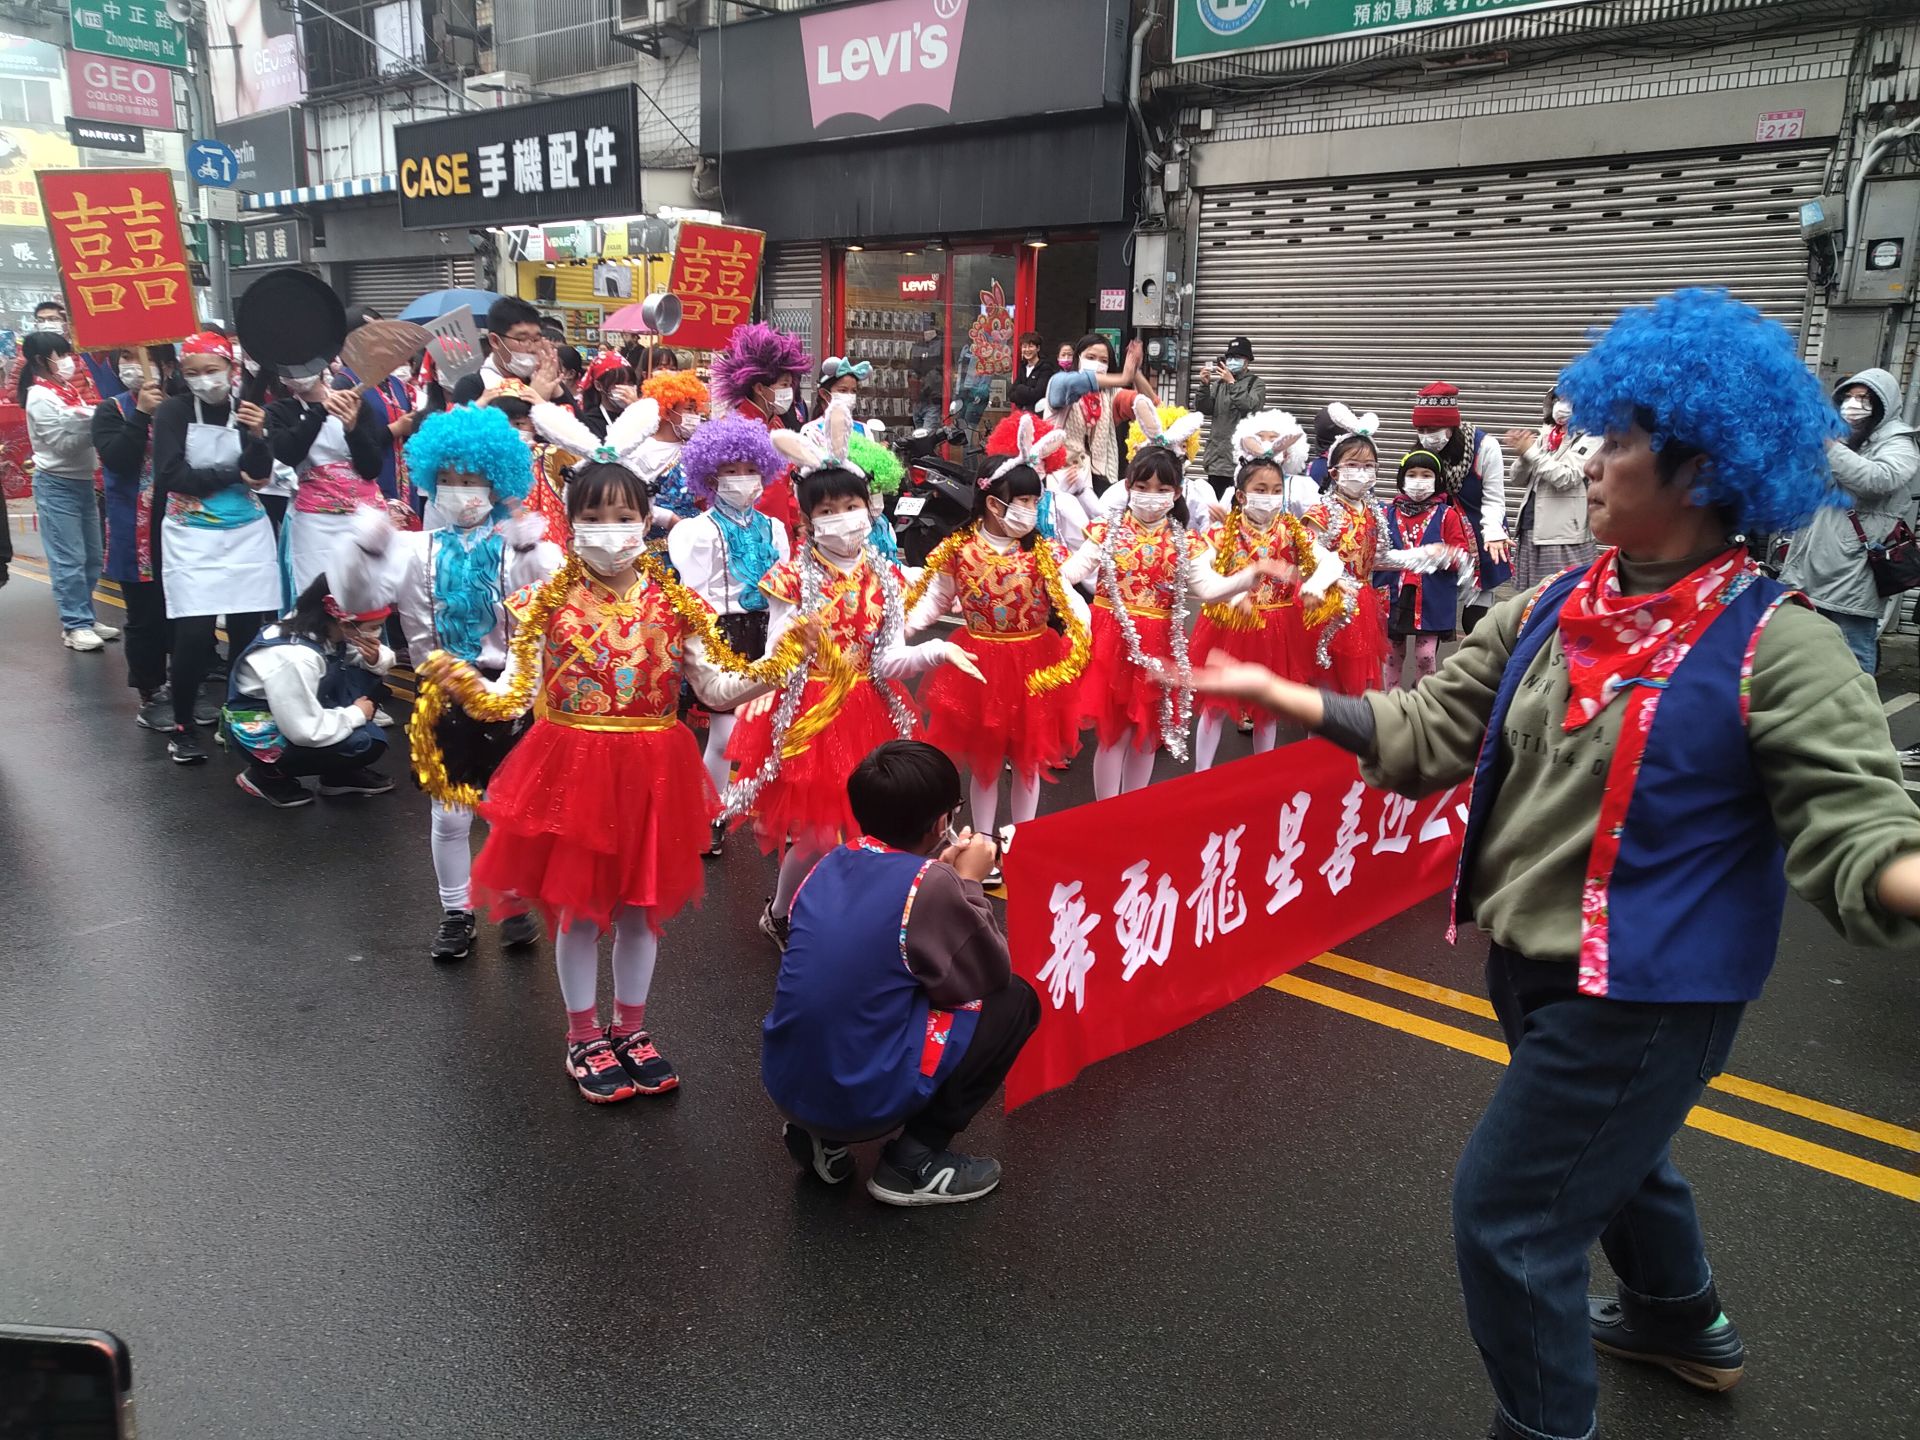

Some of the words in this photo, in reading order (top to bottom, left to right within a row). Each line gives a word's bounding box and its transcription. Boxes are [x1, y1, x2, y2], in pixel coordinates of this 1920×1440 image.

[105, 29, 160, 57] Zhongzheng
[84, 62, 156, 94] GEO
[86, 89, 127, 103] COLOR
[129, 95, 159, 108] LENS
[79, 128, 126, 142] MARKUS
[1765, 122, 1799, 139] 212
[234, 139, 256, 165] erlin
[401, 152, 471, 198] CASE
[478, 126, 617, 198] 手機配件
[1105, 298, 1123, 309] 214
